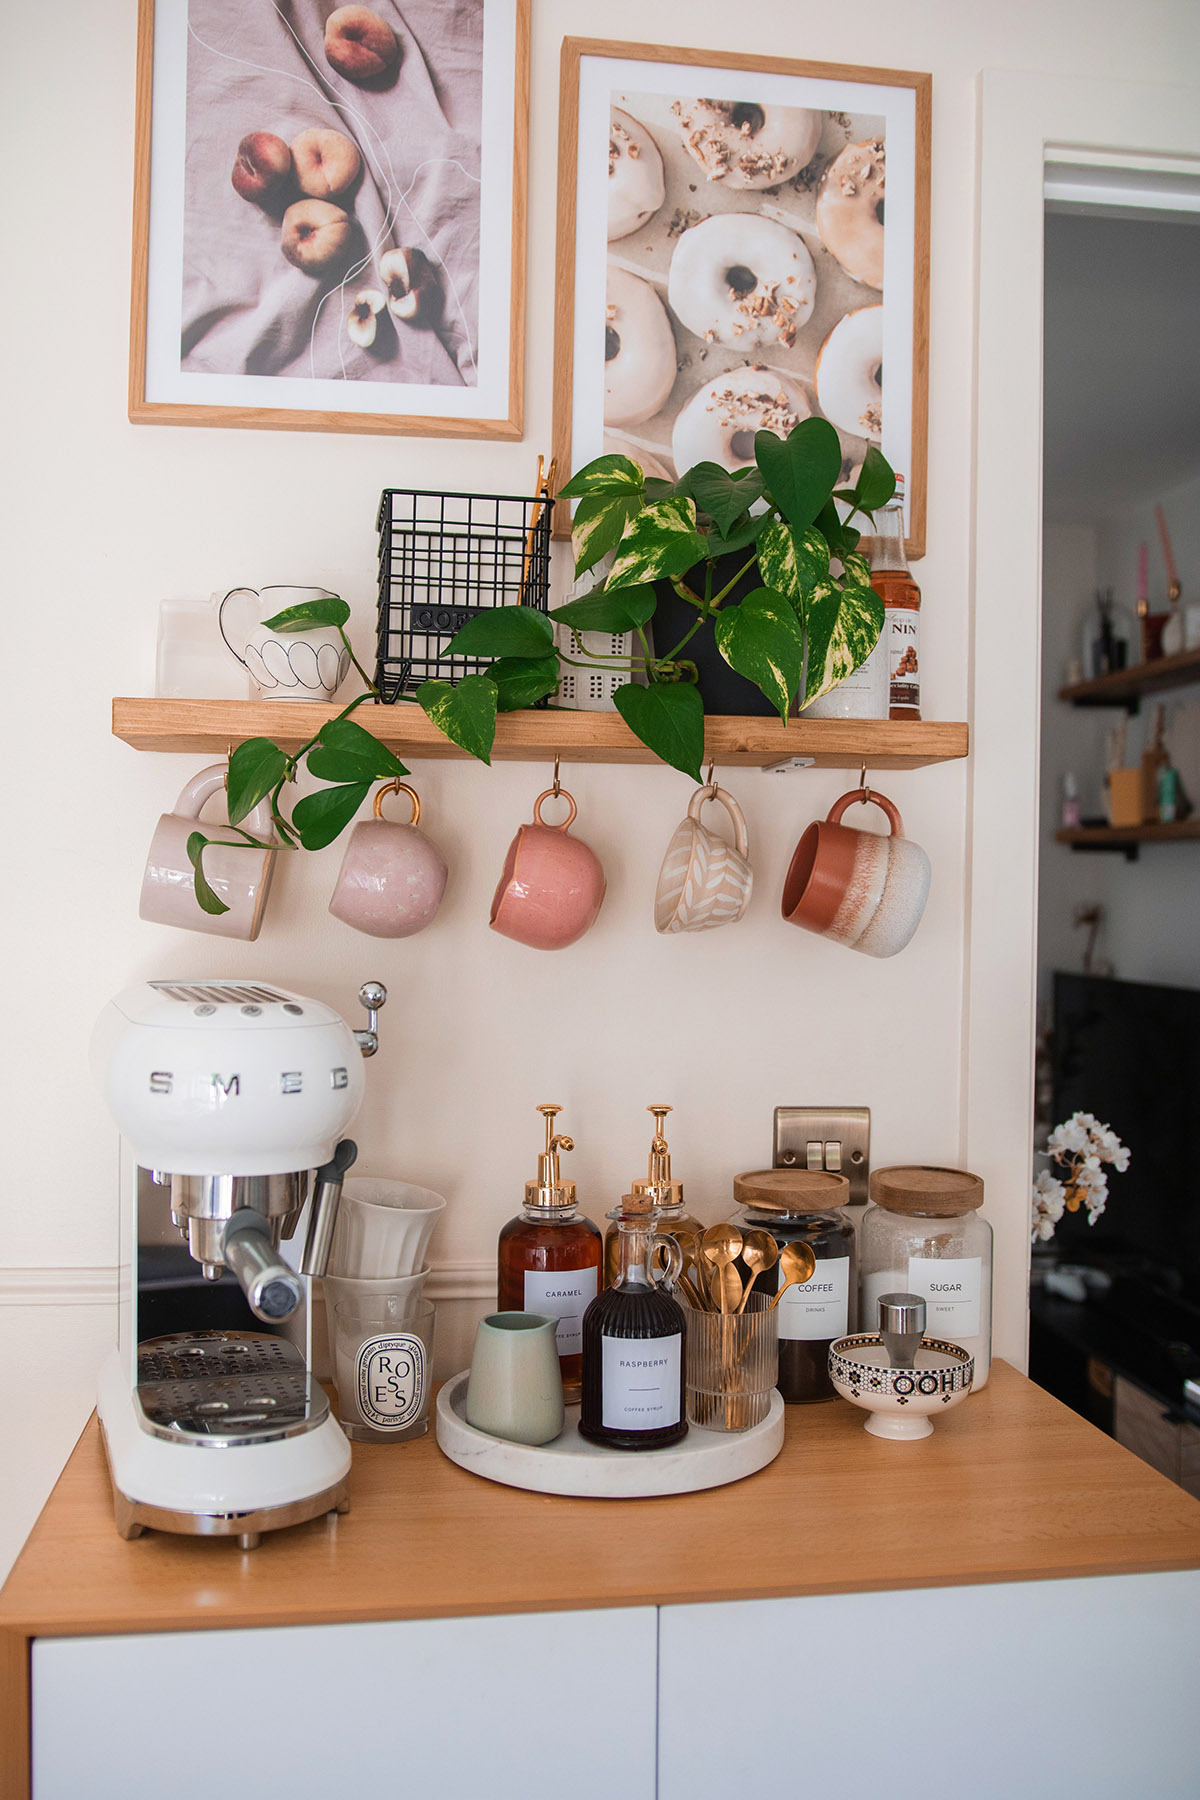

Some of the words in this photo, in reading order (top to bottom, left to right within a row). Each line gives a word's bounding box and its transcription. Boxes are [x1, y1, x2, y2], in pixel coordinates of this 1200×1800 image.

[150, 1067, 348, 1096] SMEG
[798, 1283, 833, 1293] COFFEE
[929, 1283, 962, 1292] SUGAR
[545, 1289, 582, 1298] CARAMEL
[361, 1346, 377, 1369] germain
[619, 1358, 668, 1368] RASPBERRY
[891, 1371, 954, 1395] OOH
